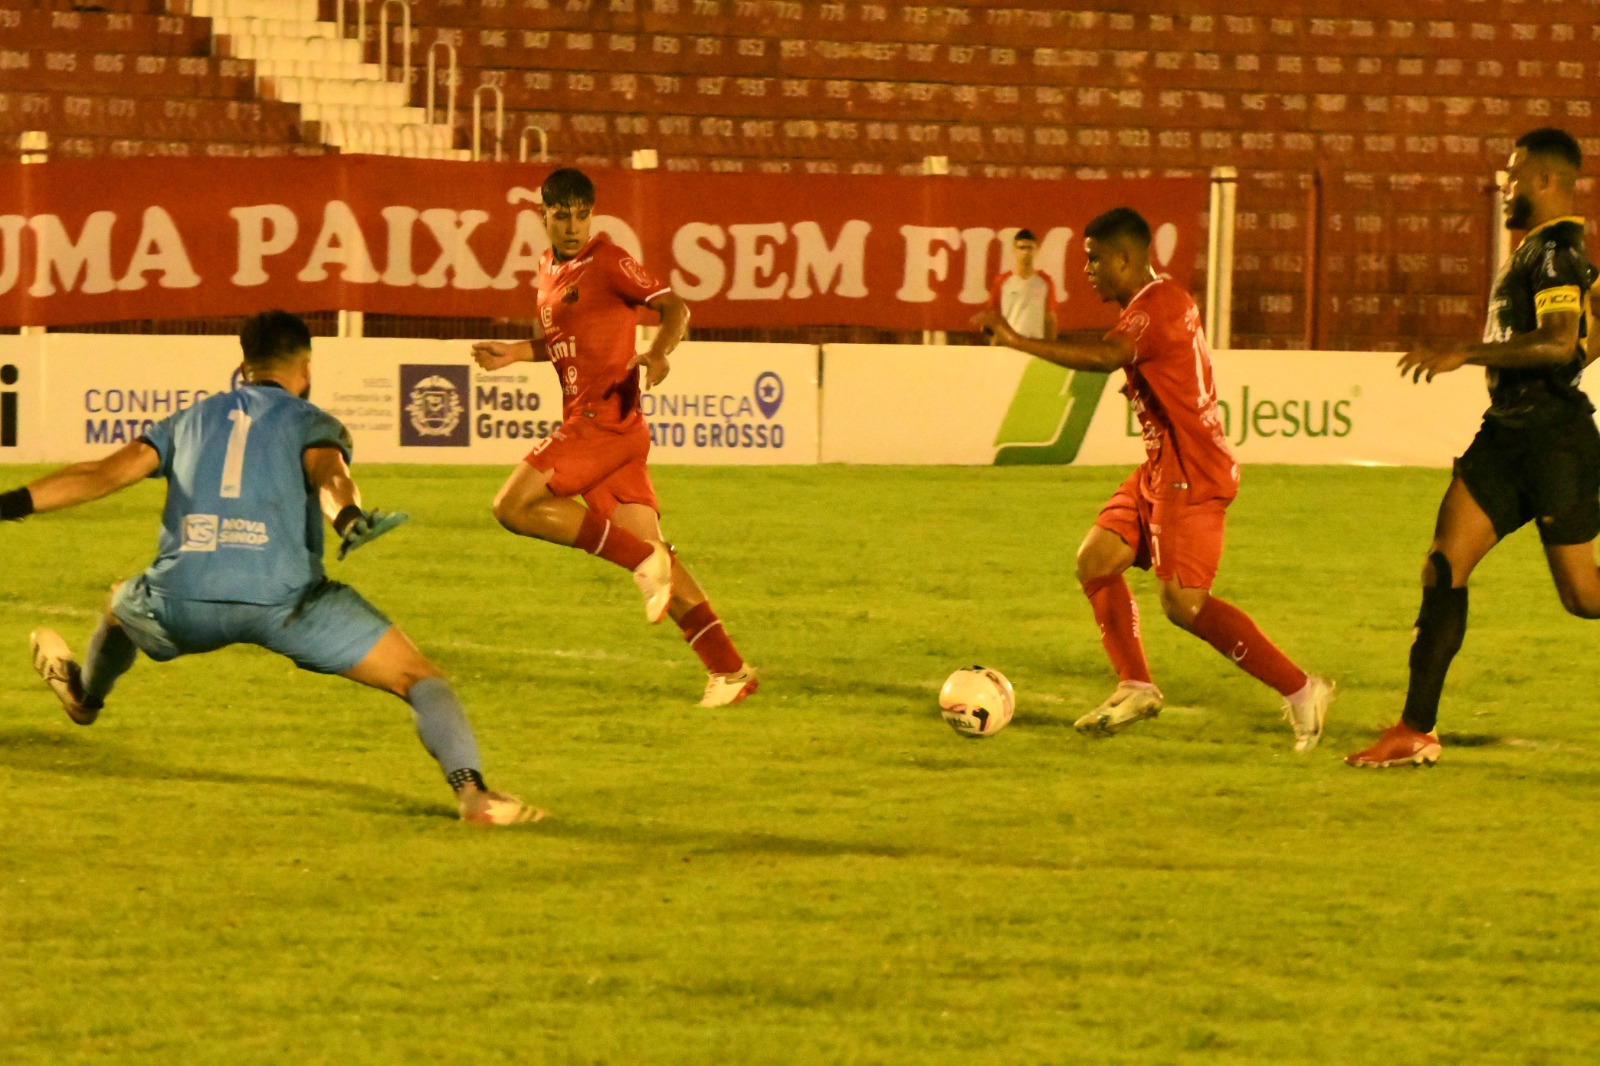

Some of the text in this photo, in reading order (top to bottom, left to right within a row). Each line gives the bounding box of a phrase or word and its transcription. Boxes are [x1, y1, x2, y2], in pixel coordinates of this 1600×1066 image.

[670, 220, 871, 302] SEM
[896, 225, 1073, 304] FIM
[85, 389, 209, 414] CONHE
[476, 386, 541, 411] Mato
[640, 393, 754, 423] ONHEÇA
[649, 422, 785, 449] ATO GROSSO
[219, 409, 252, 498] 1
[221, 518, 267, 535] NOVA
